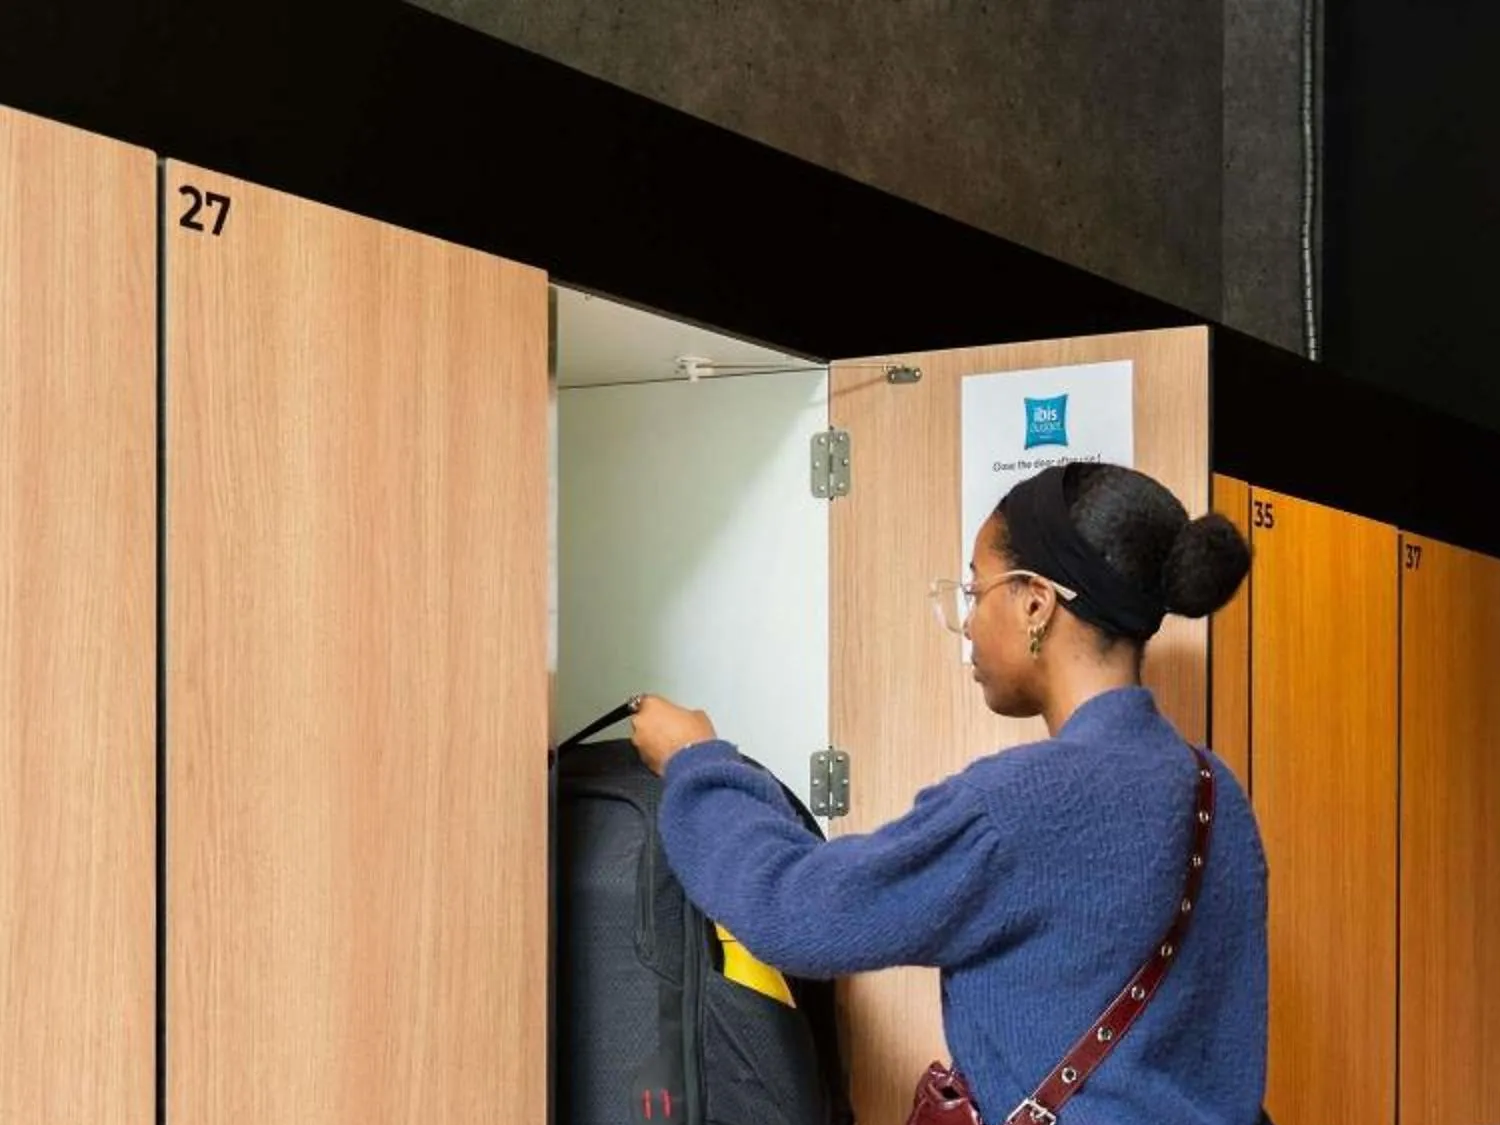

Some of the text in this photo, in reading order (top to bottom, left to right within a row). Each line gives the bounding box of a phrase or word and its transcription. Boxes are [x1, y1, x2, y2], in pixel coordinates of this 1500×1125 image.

[178, 185, 231, 236] 27
[1034, 405, 1057, 421] ibis
[1018, 460, 1031, 470] the
[1254, 501, 1274, 529] 35
[1405, 545, 1421, 570] 37
